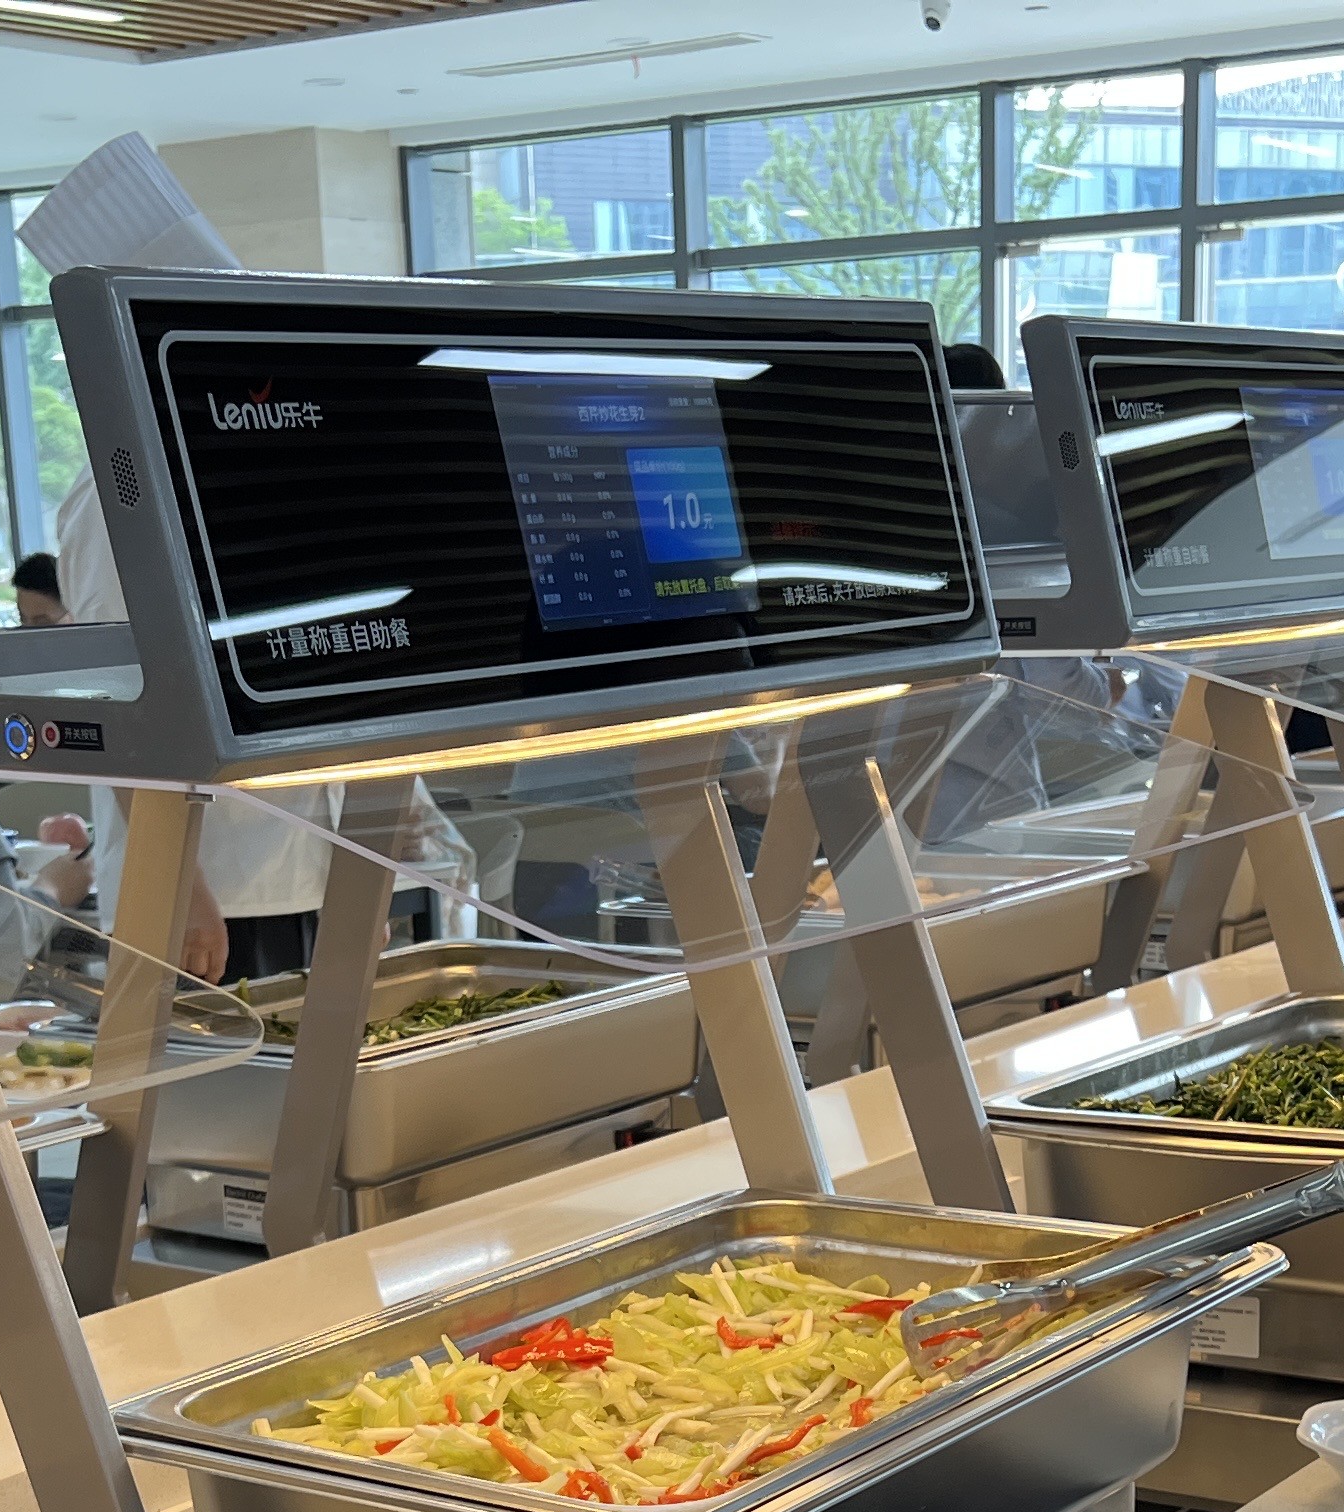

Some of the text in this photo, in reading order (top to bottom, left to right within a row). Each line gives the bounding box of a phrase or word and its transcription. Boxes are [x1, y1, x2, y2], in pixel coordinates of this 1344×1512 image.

[662, 492, 700, 530] 1.0
[266, 617, 411, 660] 计量称重自助餐
